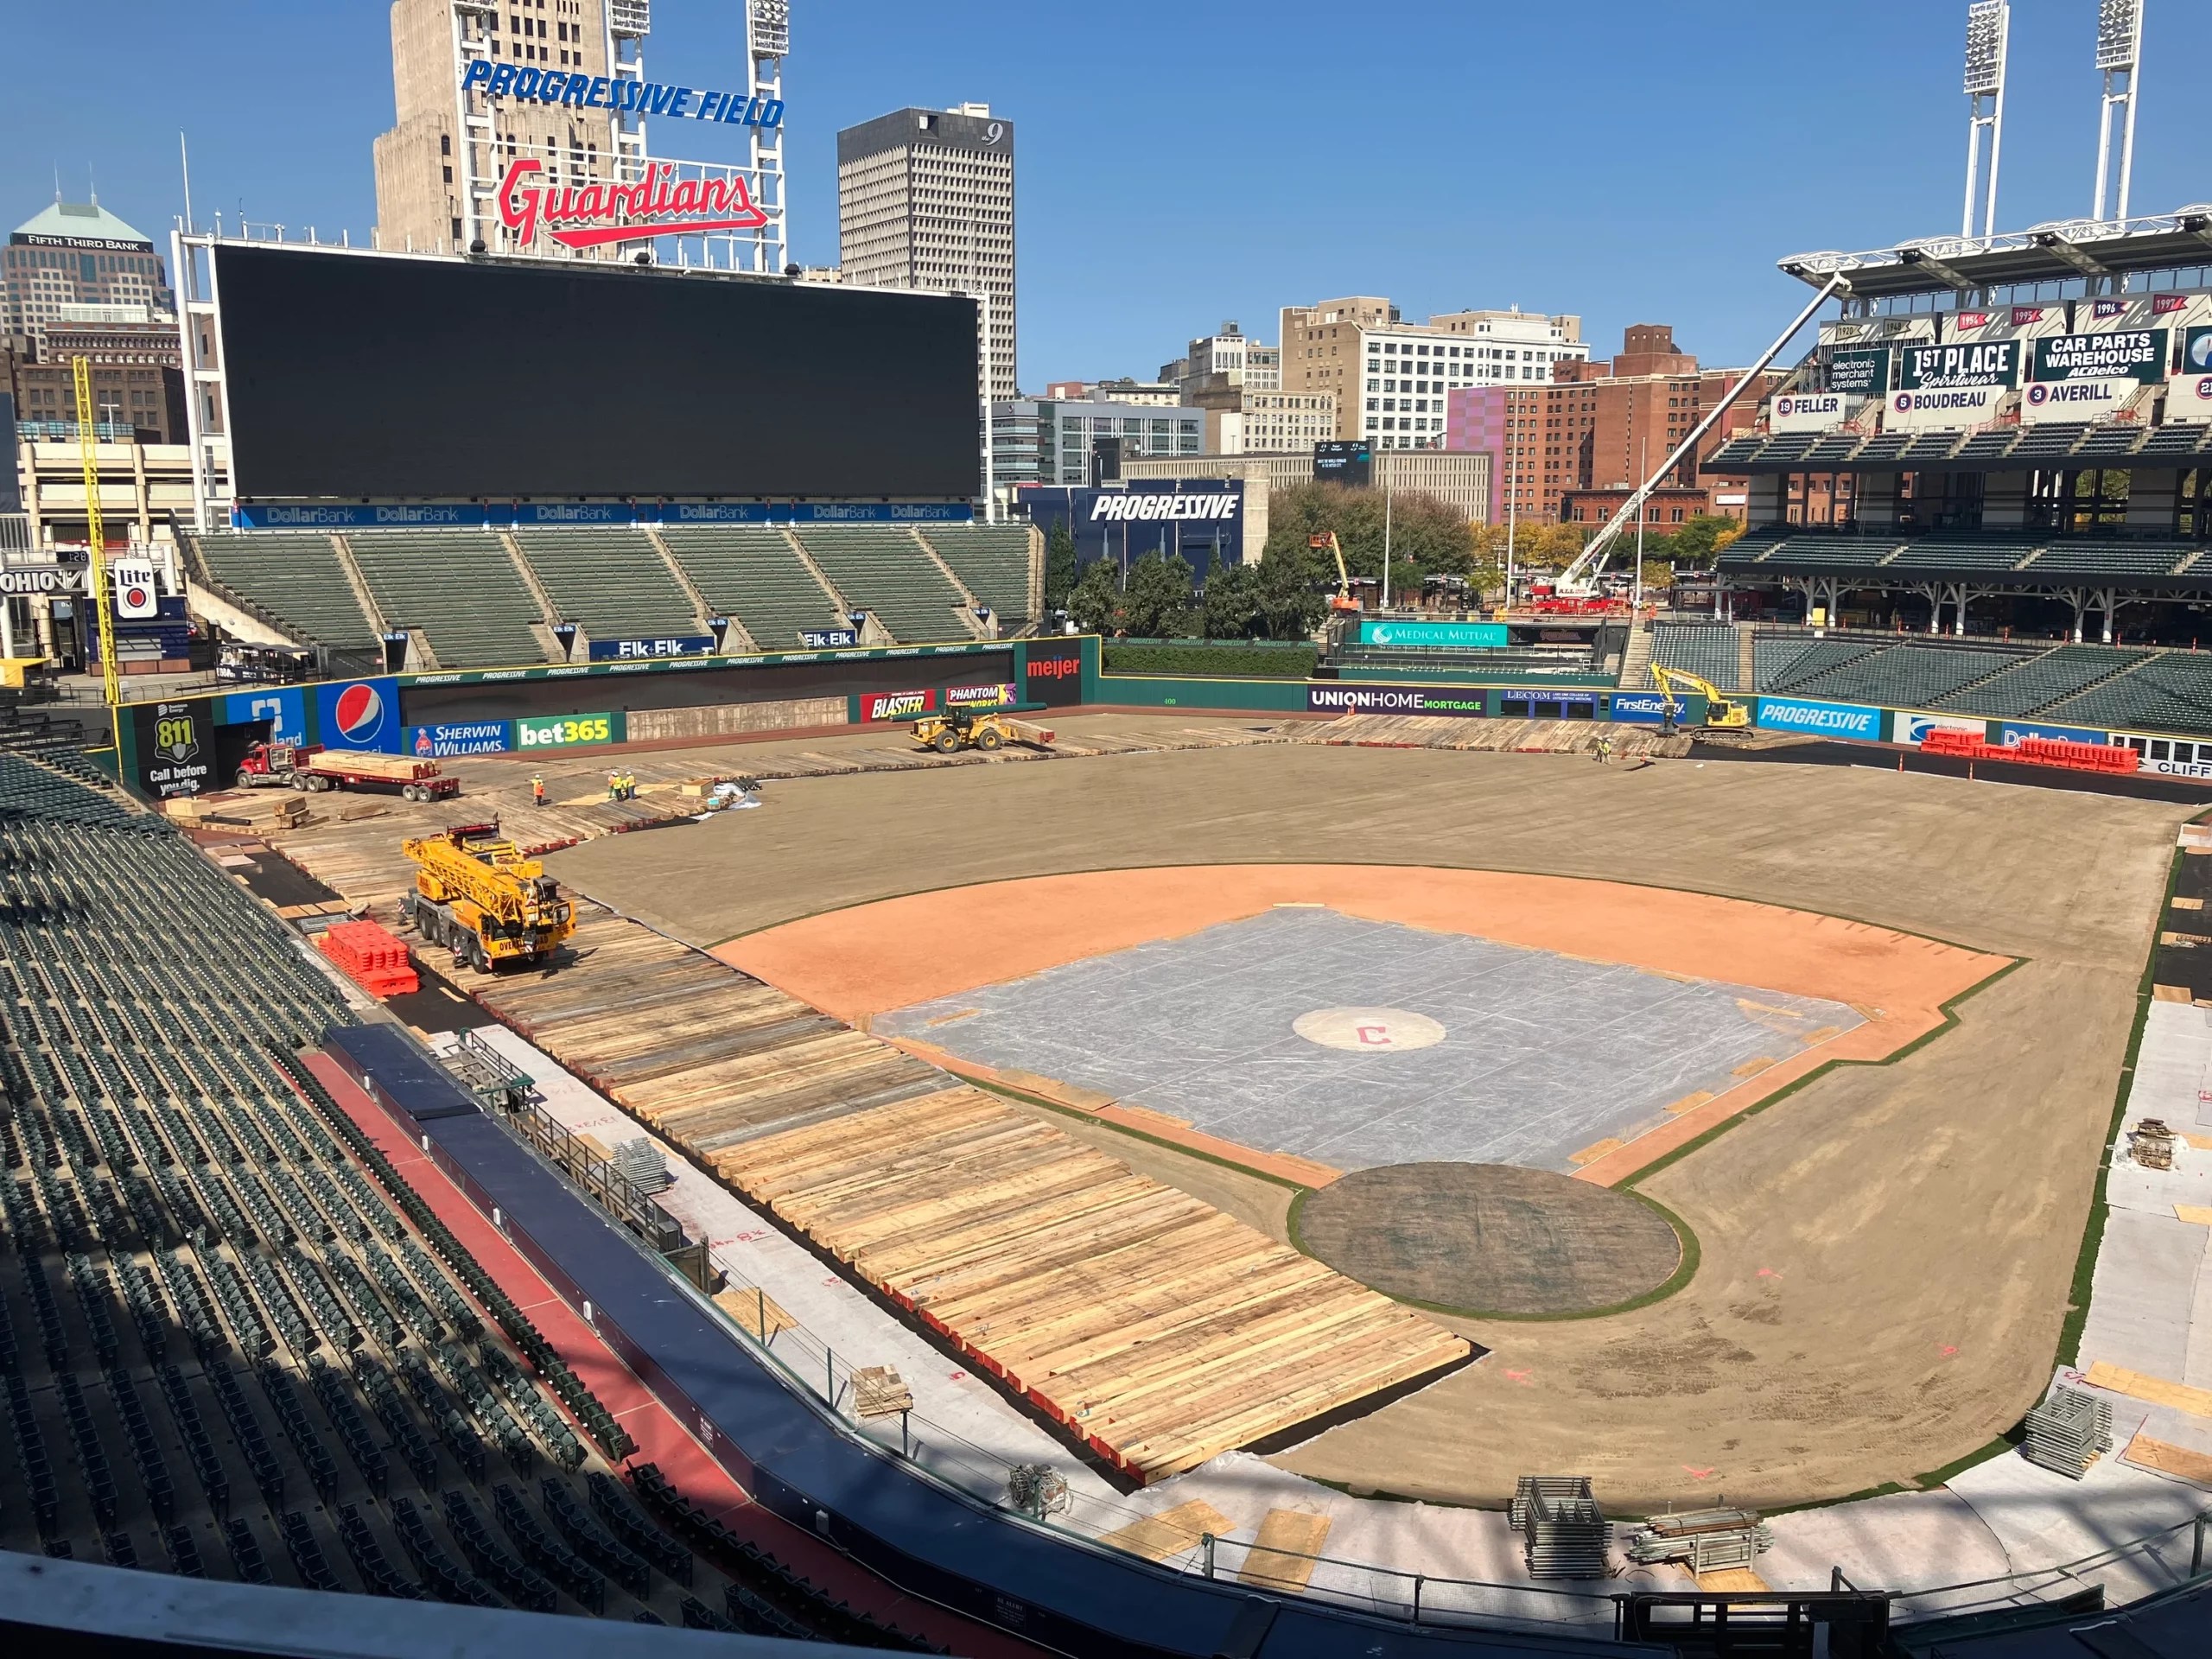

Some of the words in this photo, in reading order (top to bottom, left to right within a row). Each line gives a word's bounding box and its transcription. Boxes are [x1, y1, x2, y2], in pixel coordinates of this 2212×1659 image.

[462, 59, 692, 118] PROGRESSIVE
[696, 91, 785, 129] FIELD
[986, 123, 1004, 146] 9
[499, 157, 768, 249] Guardians
[28, 234, 62, 246] FIFTH
[65, 237, 104, 249] THIRD
[105, 240, 140, 251] BANK
[2097, 303, 2116, 315] 1996
[2157, 298, 2176, 309] 1997
[1961, 315, 1979, 326] 1954
[2016, 310, 2032, 321] 1995
[1838, 326, 1854, 336] 1920
[1886, 322, 1902, 333] 1948
[2051, 338, 2087, 353] CAR
[2091, 333, 2151, 351] PARTS
[1833, 359, 1875, 371] electronic
[1912, 349, 1942, 377] 1ST
[1944, 344, 2011, 375] PLACE
[2045, 347, 2154, 368] WAREHOUSE
[1832, 368, 1874, 379] merchant
[2066, 364, 2129, 378] ACDelco
[1831, 378, 1869, 390] systems
[1919, 369, 1999, 390] Spiritwear
[1899, 397, 1907, 407] 5
[1913, 391, 1986, 410] BOUDREAU
[2034, 389, 2042, 400] 3
[2049, 384, 2113, 403] AVERILL
[1780, 401, 1790, 412] 19
[1794, 397, 1839, 414] FELLER
[267, 506, 353, 523] DollarBank
[377, 505, 458, 522] DollarBank
[536, 505, 611, 520] DollarBank
[680, 505, 748, 519] DollarBank
[813, 504, 876, 518] DollarBank
[891, 504, 950, 518] DollarBank
[1090, 494, 1240, 521] PROGRESSIVE
[0, 571, 55, 594] OHIO
[118, 569, 151, 588] Lite
[1395, 628, 1445, 640] MEDICAL
[1448, 629, 1497, 641] MUTUAL
[669, 660, 709, 669] PROGRESSIVE
[727, 657, 765, 665] PROGRESSIVE
[782, 653, 818, 662] PROGRESSIVE
[482, 670, 528, 680] PROGRESSIVE
[546, 666, 591, 677] PROGRESSIVE
[608, 663, 651, 672] PROGRESSIVE
[1027, 655, 1080, 680] meijer
[415, 673, 461, 683] PROGRESSIVE
[950, 685, 999, 701] PHANTOM
[871, 696, 925, 719] BLASTER
[1424, 700, 1482, 710] MORTGAGE
[1616, 698, 1685, 714] FirstEney
[1760, 703, 1873, 732] PROGRESSIVE
[157, 715, 192, 748] 811
[434, 724, 501, 741] SHERWIN
[520, 720, 608, 746] bet365
[149, 768, 171, 782] Call
[173, 765, 207, 779] before
[2158, 762, 2211, 777] CLIFF
[1356, 1026, 1392, 1046] C
